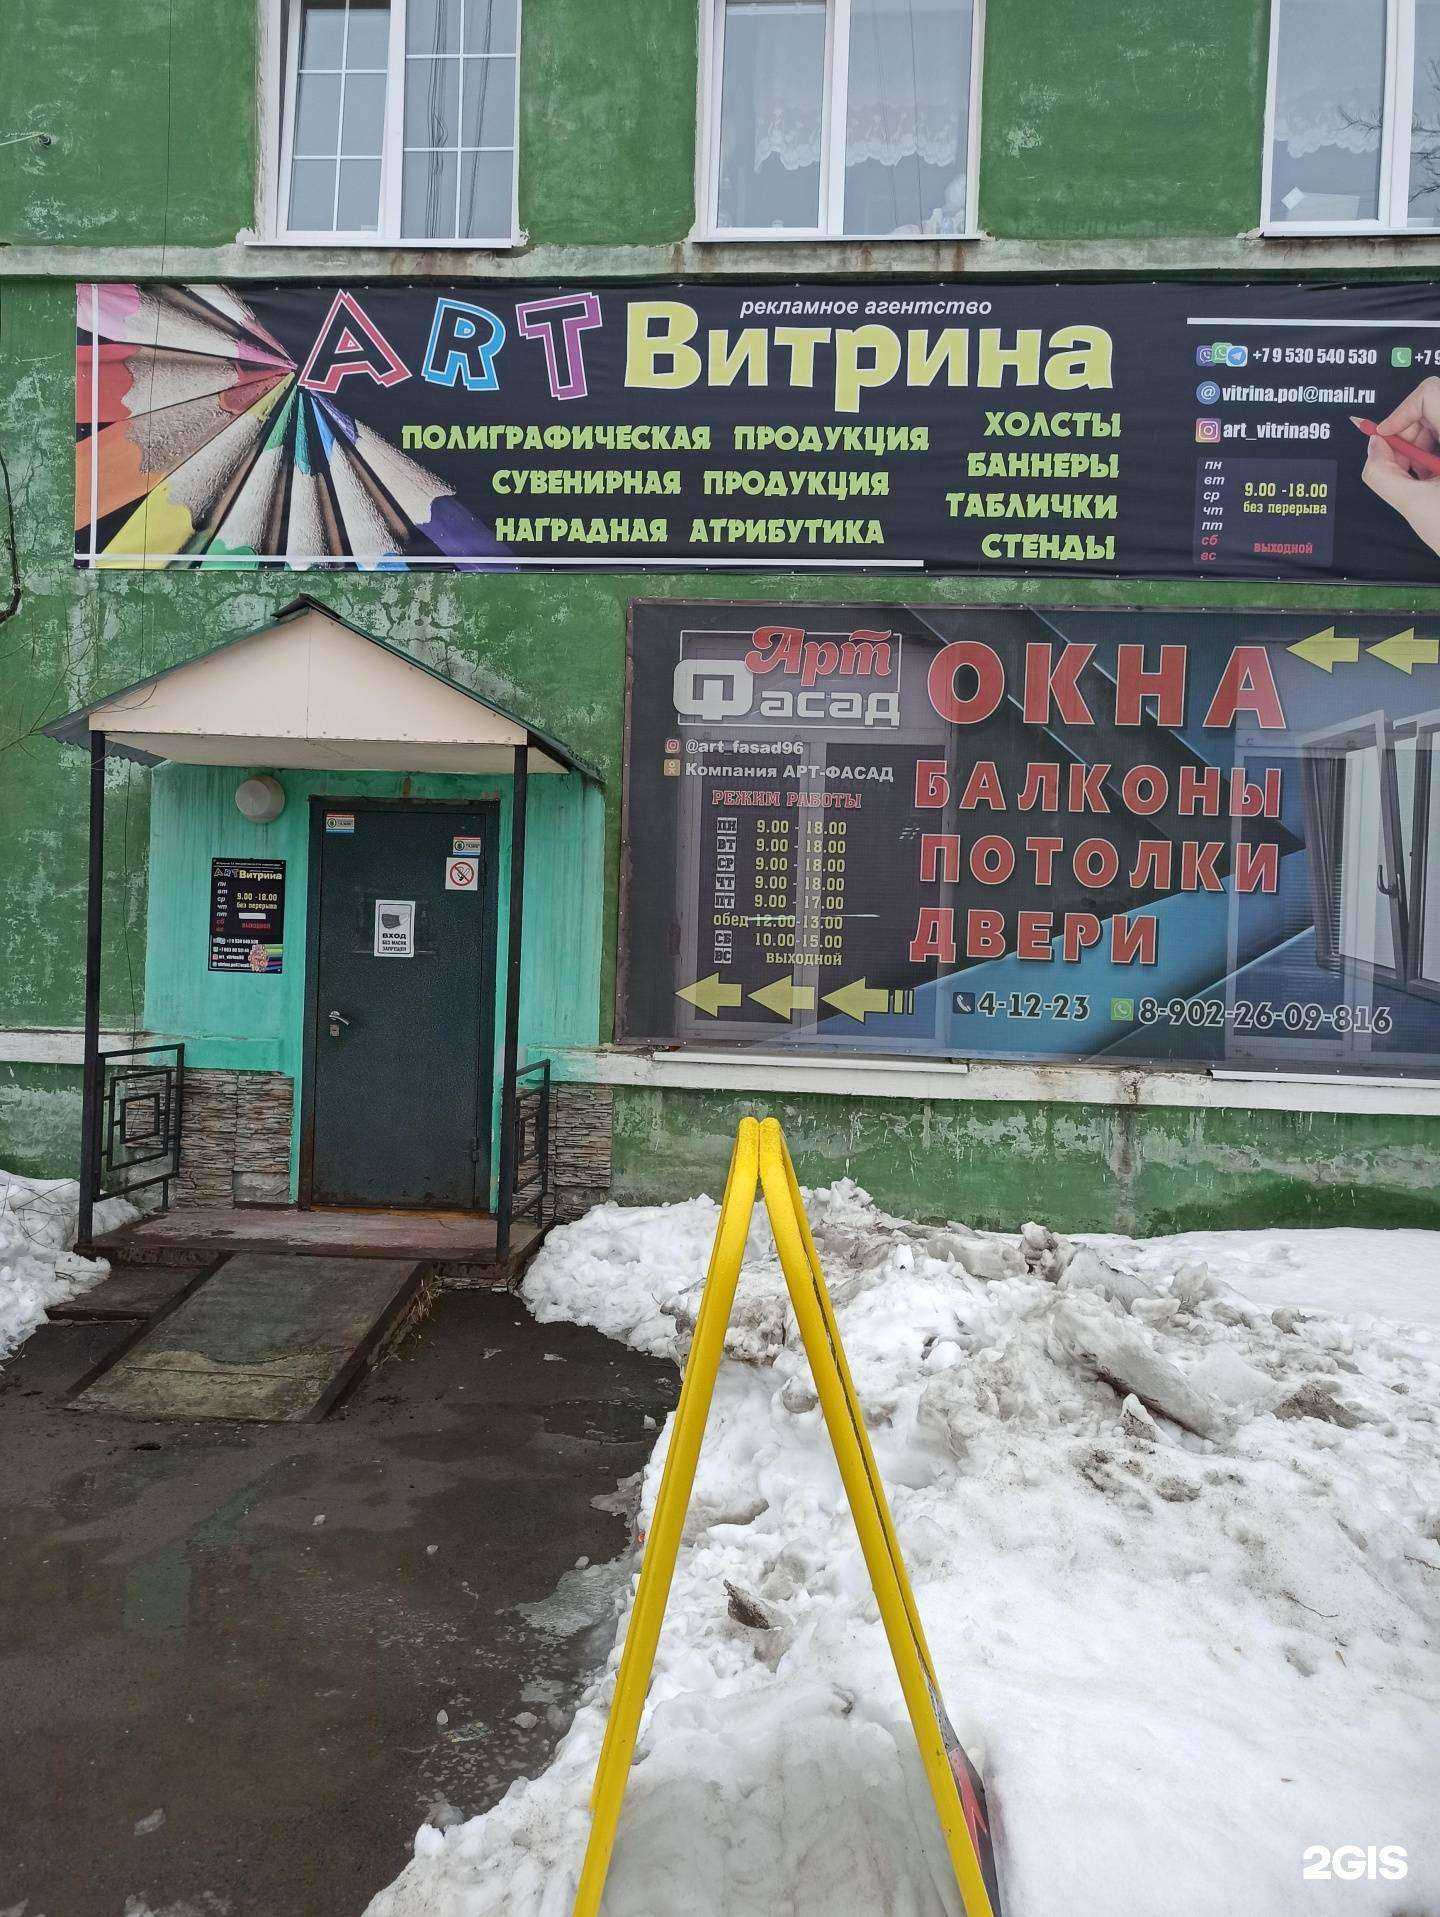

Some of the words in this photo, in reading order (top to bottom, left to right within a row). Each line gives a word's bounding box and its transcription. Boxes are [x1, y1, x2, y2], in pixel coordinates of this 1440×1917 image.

[741, 300, 858, 318] рекламное
[865, 302, 992, 316] агентство
[298, 288, 603, 401] ART
[624, 301, 1114, 413] Витрина
[1285, 348, 1314, 363] 530
[1317, 348, 1345, 363] 540
[1348, 349, 1377, 364] 530
[1223, 386, 1376, 404] vitrina.pol@mail.ru
[984, 411, 1121, 437] ХОЛСТЫ
[1223, 422, 1330, 440] art_vitrina96
[402, 425, 711, 450] ПОЛИГРАФИЧЕСКАЯ
[734, 426, 929, 456] ПРОДУКЦИЯ
[967, 452, 1120, 478] БАННЕРЫ
[1204, 461, 1222, 470] пн
[492, 470, 681, 494] СУВЕНИРНАЯ
[704, 471, 889, 500] ПРОДУКЦИЯ
[1204, 476, 1225, 485] вт
[1244, 482, 1276, 497] 9.00
[1203, 491, 1220, 502] ср
[945, 493, 1118, 519] ТАБЛИЧКИ
[1203, 506, 1223, 516] чт
[1243, 501, 1263, 513] без
[1267, 503, 1328, 516] перерыва
[495, 517, 668, 543] НАГРАДНАЯ
[689, 519, 885, 544] АТРИБУТИКА
[1201, 521, 1223, 531] пт
[981, 534, 1116, 560] СТЕНДЫ
[1201, 534, 1219, 546] сб
[1253, 542, 1314, 554] выходной
[1200, 552, 1217, 560] вс
[744, 625, 892, 687] Арт
[673, 659, 900, 726] Фасад
[927, 640, 1287, 729] ОКНА
[685, 739, 804, 755] @art_fasad96
[685, 762, 777, 777] Компания
[782, 764, 894, 783] АРТ-ФАСАД
[914, 759, 1281, 818] БАЛКОНЫ
[712, 789, 780, 807] РЕЖИМ
[786, 791, 862, 809] РАБОТЫ
[756, 819, 789, 834] 9.00
[806, 820, 847, 836] 18.00
[756, 838, 789, 852] 9.00
[806, 839, 846, 854] 18.00
[755, 856, 788, 871] 9.00
[805, 858, 846, 873] 18.00
[919, 834, 1279, 893] ПОТОЛКИ
[239, 869, 283, 881] Витрина
[754, 875, 787, 890] 9.00
[805, 877, 845, 892] 18.00
[754, 894, 787, 908] 9.00
[804, 895, 844, 910] 17.00
[713, 912, 749, 928] обед
[909, 907, 1157, 964] ДВЕРИ
[976, 991, 1091, 1021] 4-12-23
[1139, 1001, 1393, 1034] 8-902-26-09-816
